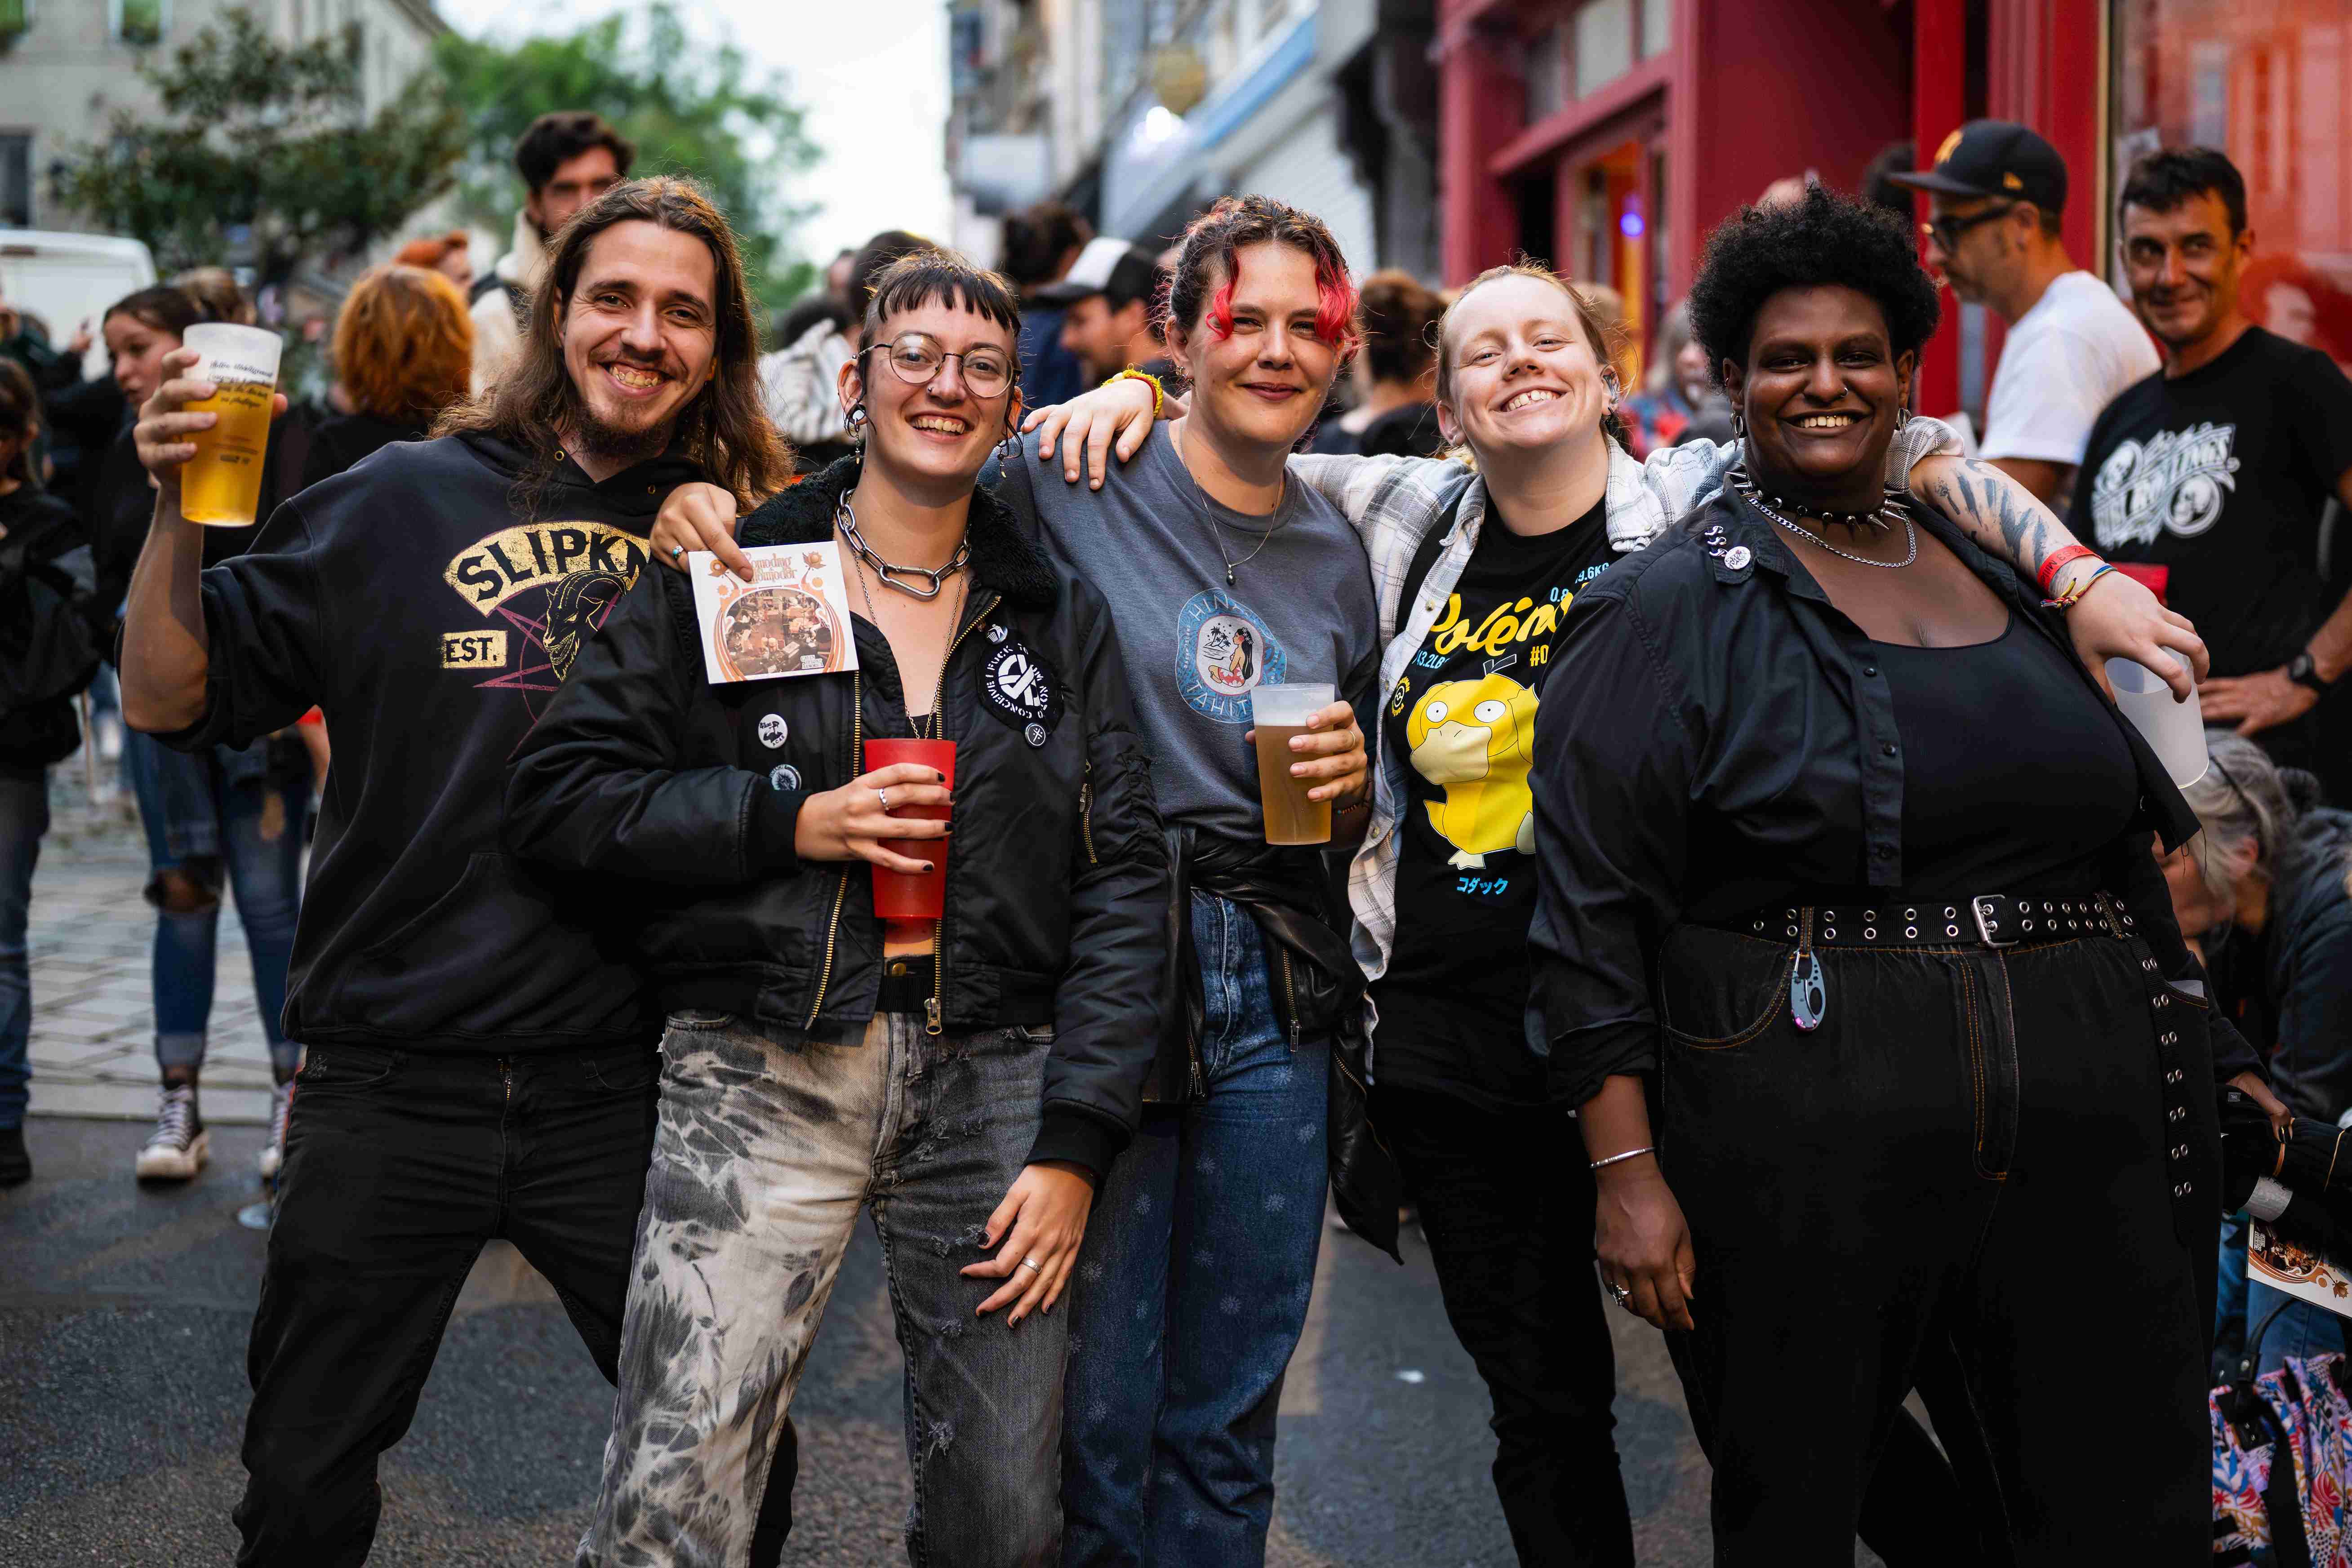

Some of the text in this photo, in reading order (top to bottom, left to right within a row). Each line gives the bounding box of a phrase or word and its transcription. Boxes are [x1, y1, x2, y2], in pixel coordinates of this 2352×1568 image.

[457, 529, 648, 601] SLIPKN
[1574, 562, 1609, 584] 9.6KG
[445, 636, 497, 663] EST.
[987, 644, 1014, 671] FUCK
[1031, 662, 1044, 682] UM
[986, 680, 1033, 719] CONCEIVE
[1187, 680, 1248, 716] TAHIT
[1457, 876, 1508, 895] コダック
